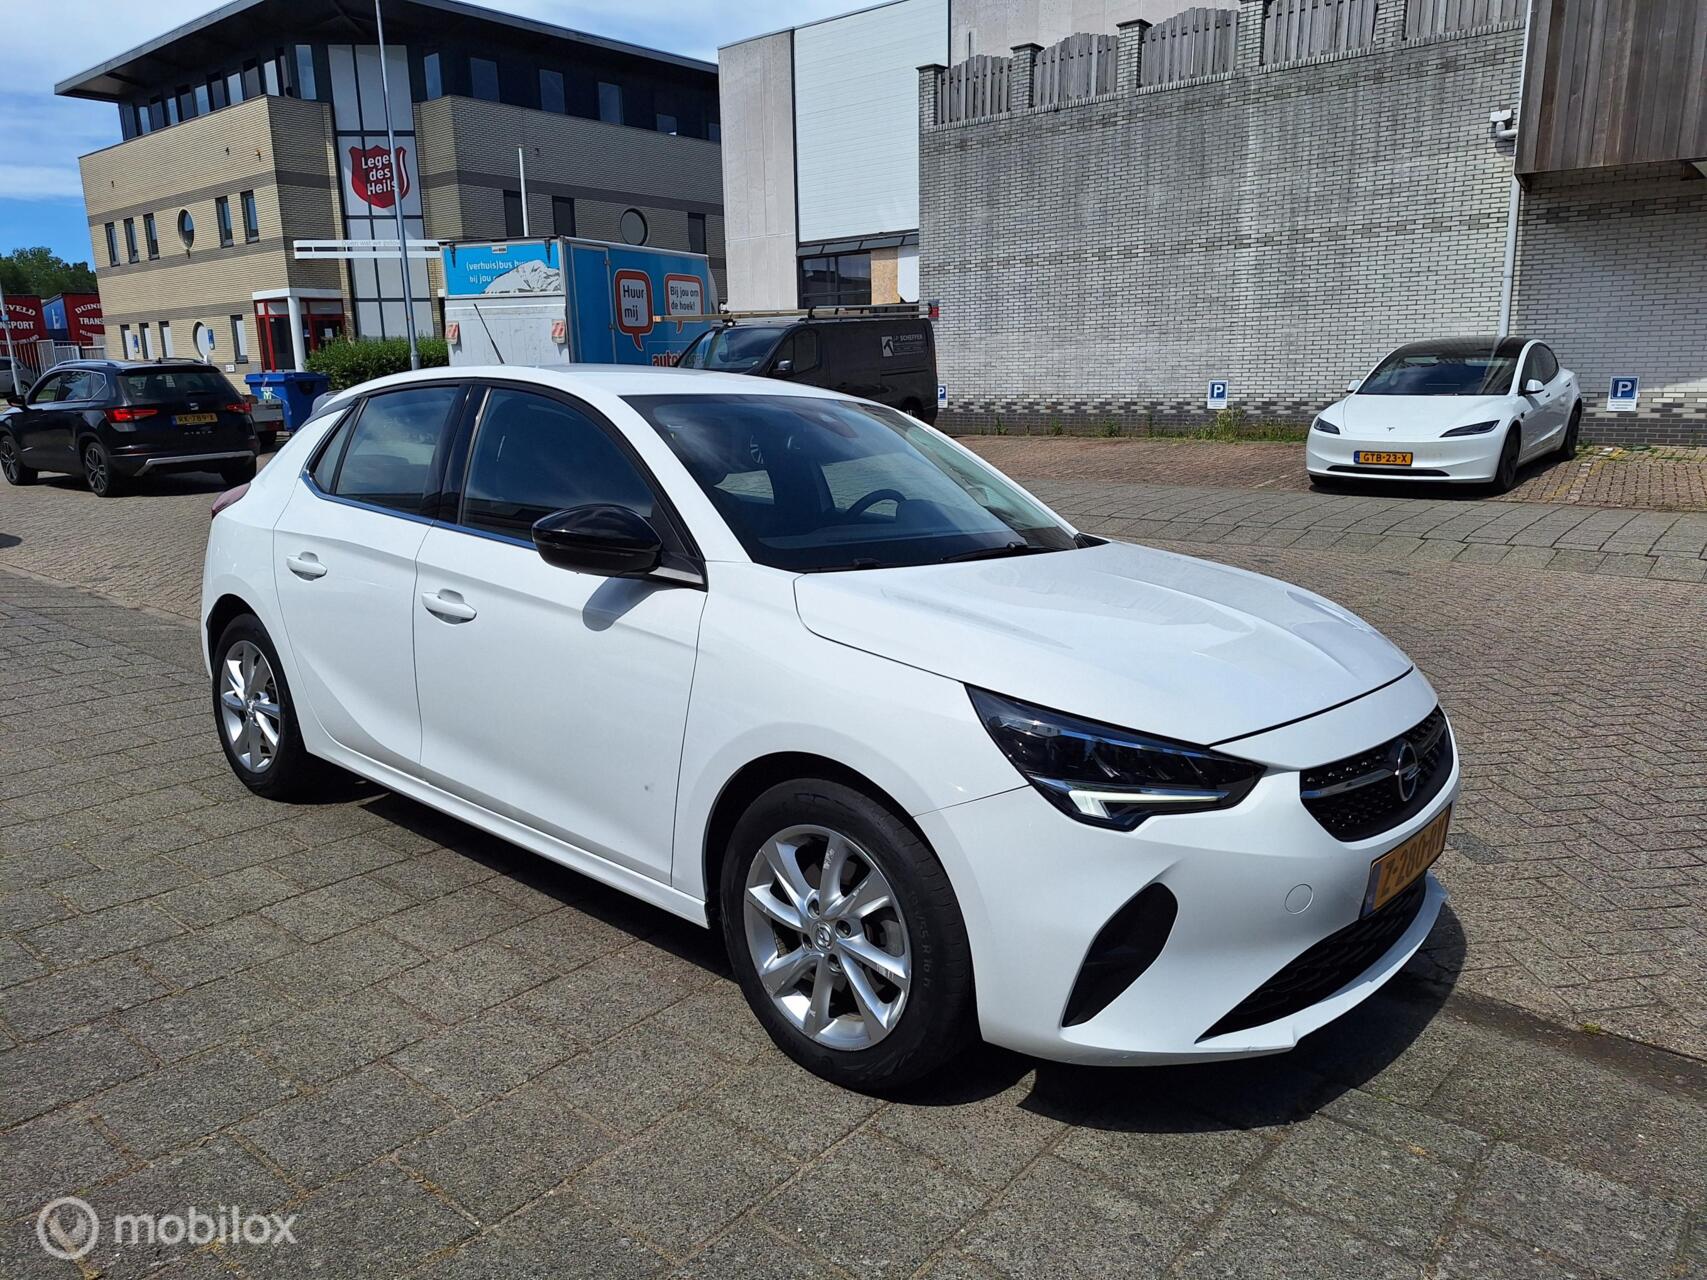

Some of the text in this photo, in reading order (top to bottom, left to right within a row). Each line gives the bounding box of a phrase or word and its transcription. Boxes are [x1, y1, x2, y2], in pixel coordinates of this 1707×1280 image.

[362, 154, 394, 169] Lege
[369, 168, 391, 181] des
[367, 179, 398, 195] Heils
[469, 274, 492, 284] bij jou
[622, 284, 645, 299] Huur
[670, 286, 679, 298] Bij
[679, 287, 689, 298] jou
[671, 300, 696, 311] de hoek!
[624, 305, 639, 321] mij
[938, 387, 945, 398] P
[1213, 384, 1224, 398] P
[1617, 381, 1632, 397] P
[1363, 453, 1408, 464] GTB-23-X
